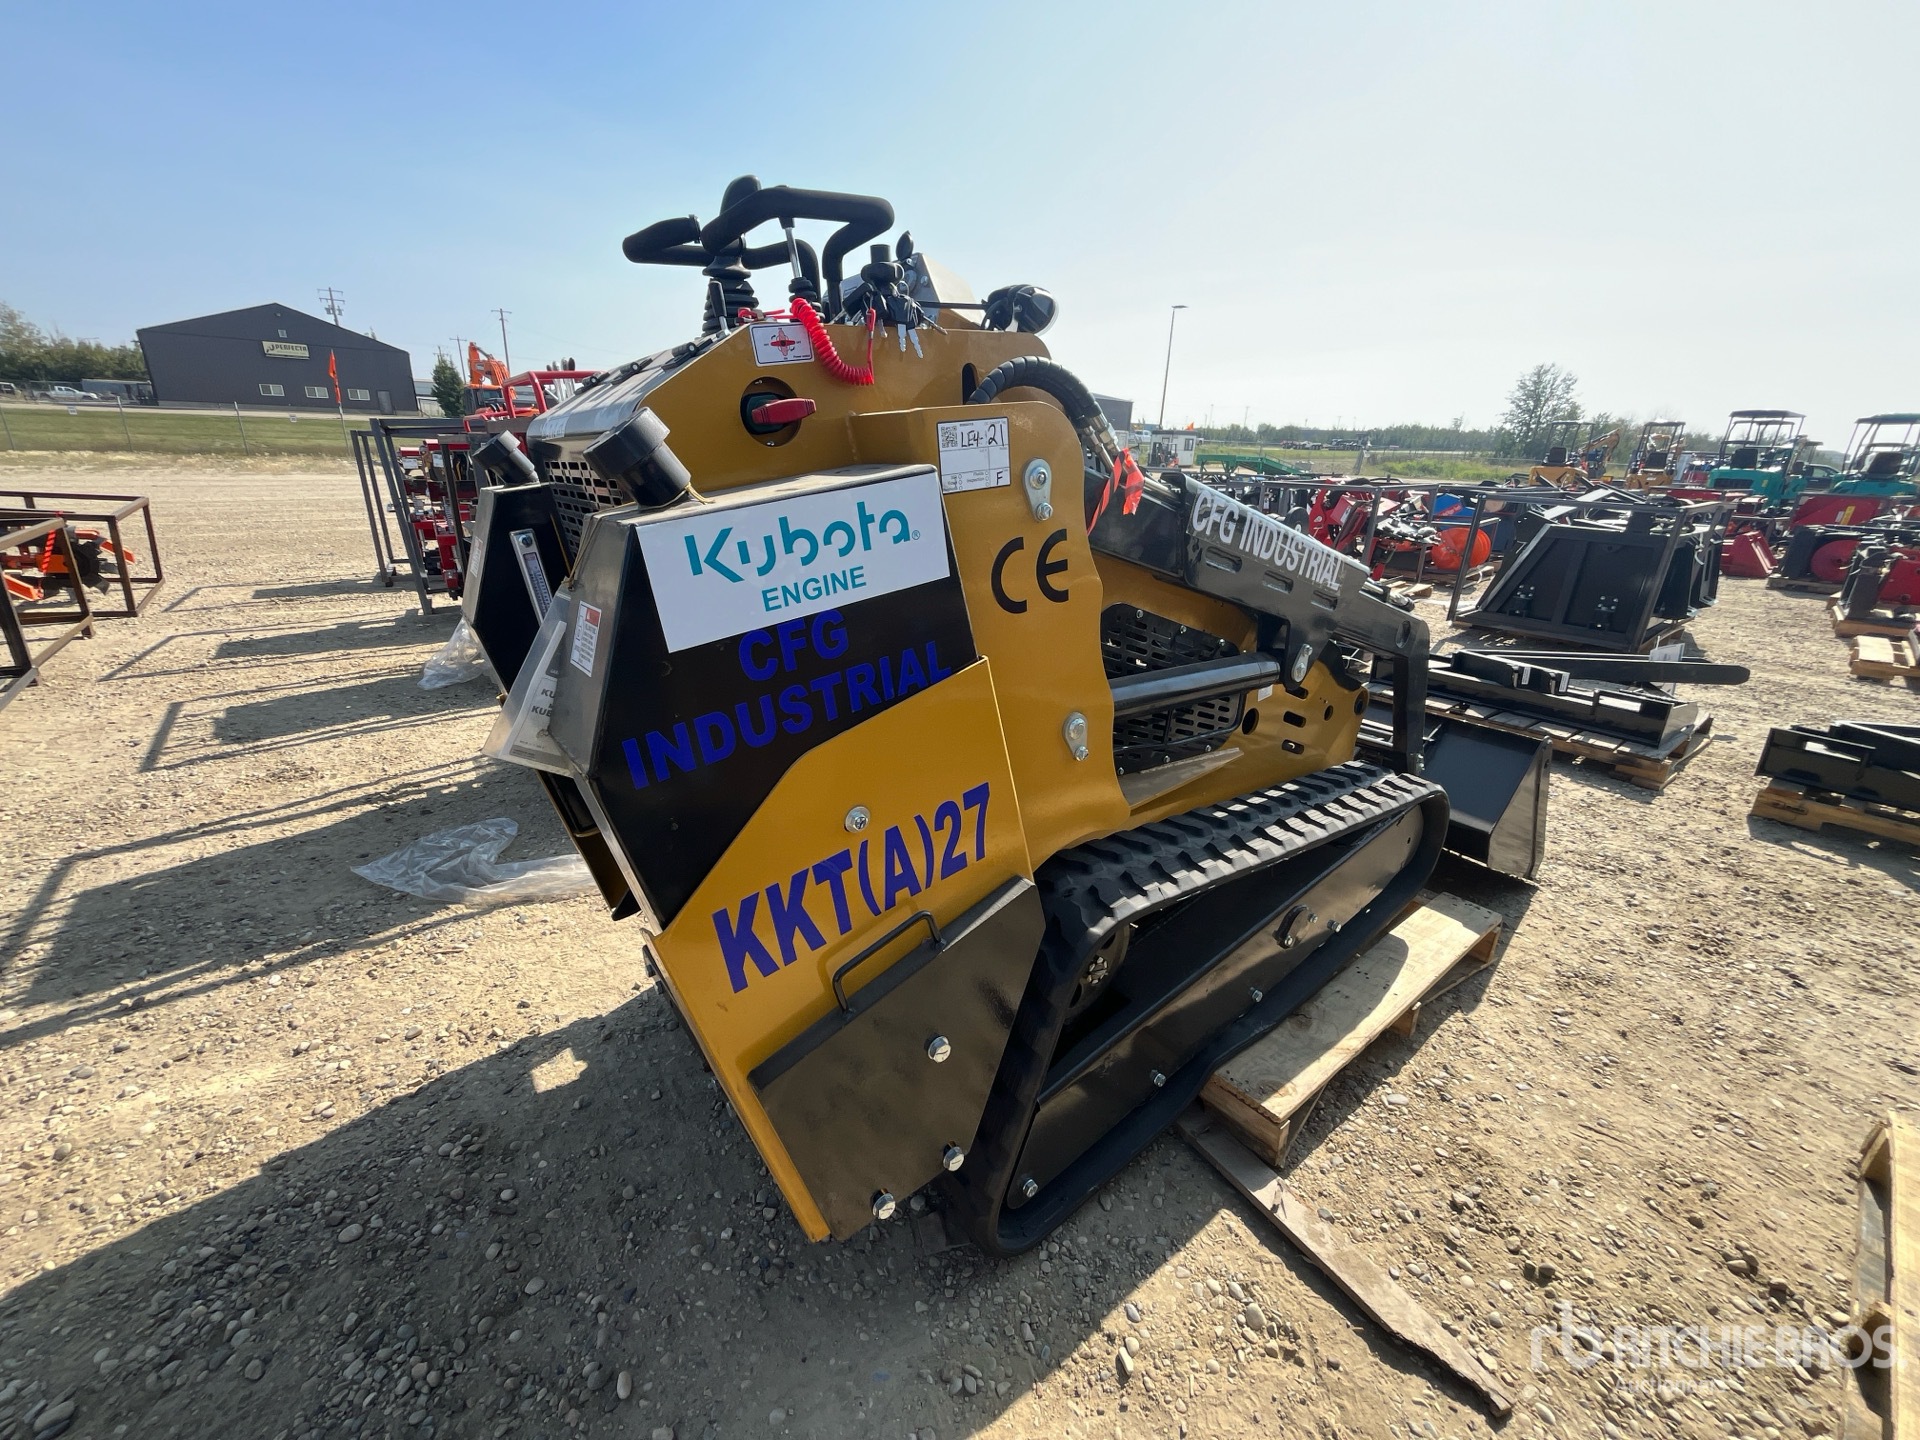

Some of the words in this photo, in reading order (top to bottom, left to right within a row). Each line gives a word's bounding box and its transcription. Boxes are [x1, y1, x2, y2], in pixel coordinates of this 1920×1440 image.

[996, 470, 1004, 486] F
[684, 500, 911, 584] Kubota
[991, 528, 1069, 614] CE
[1192, 489, 1240, 545] CFG
[1239, 517, 1343, 591] INDUSTRIAL
[761, 565, 867, 612] ENGINE
[738, 609, 850, 682] CFG
[621, 640, 952, 790] INDUSTRIAL
[711, 781, 991, 994] KKT(A)27
